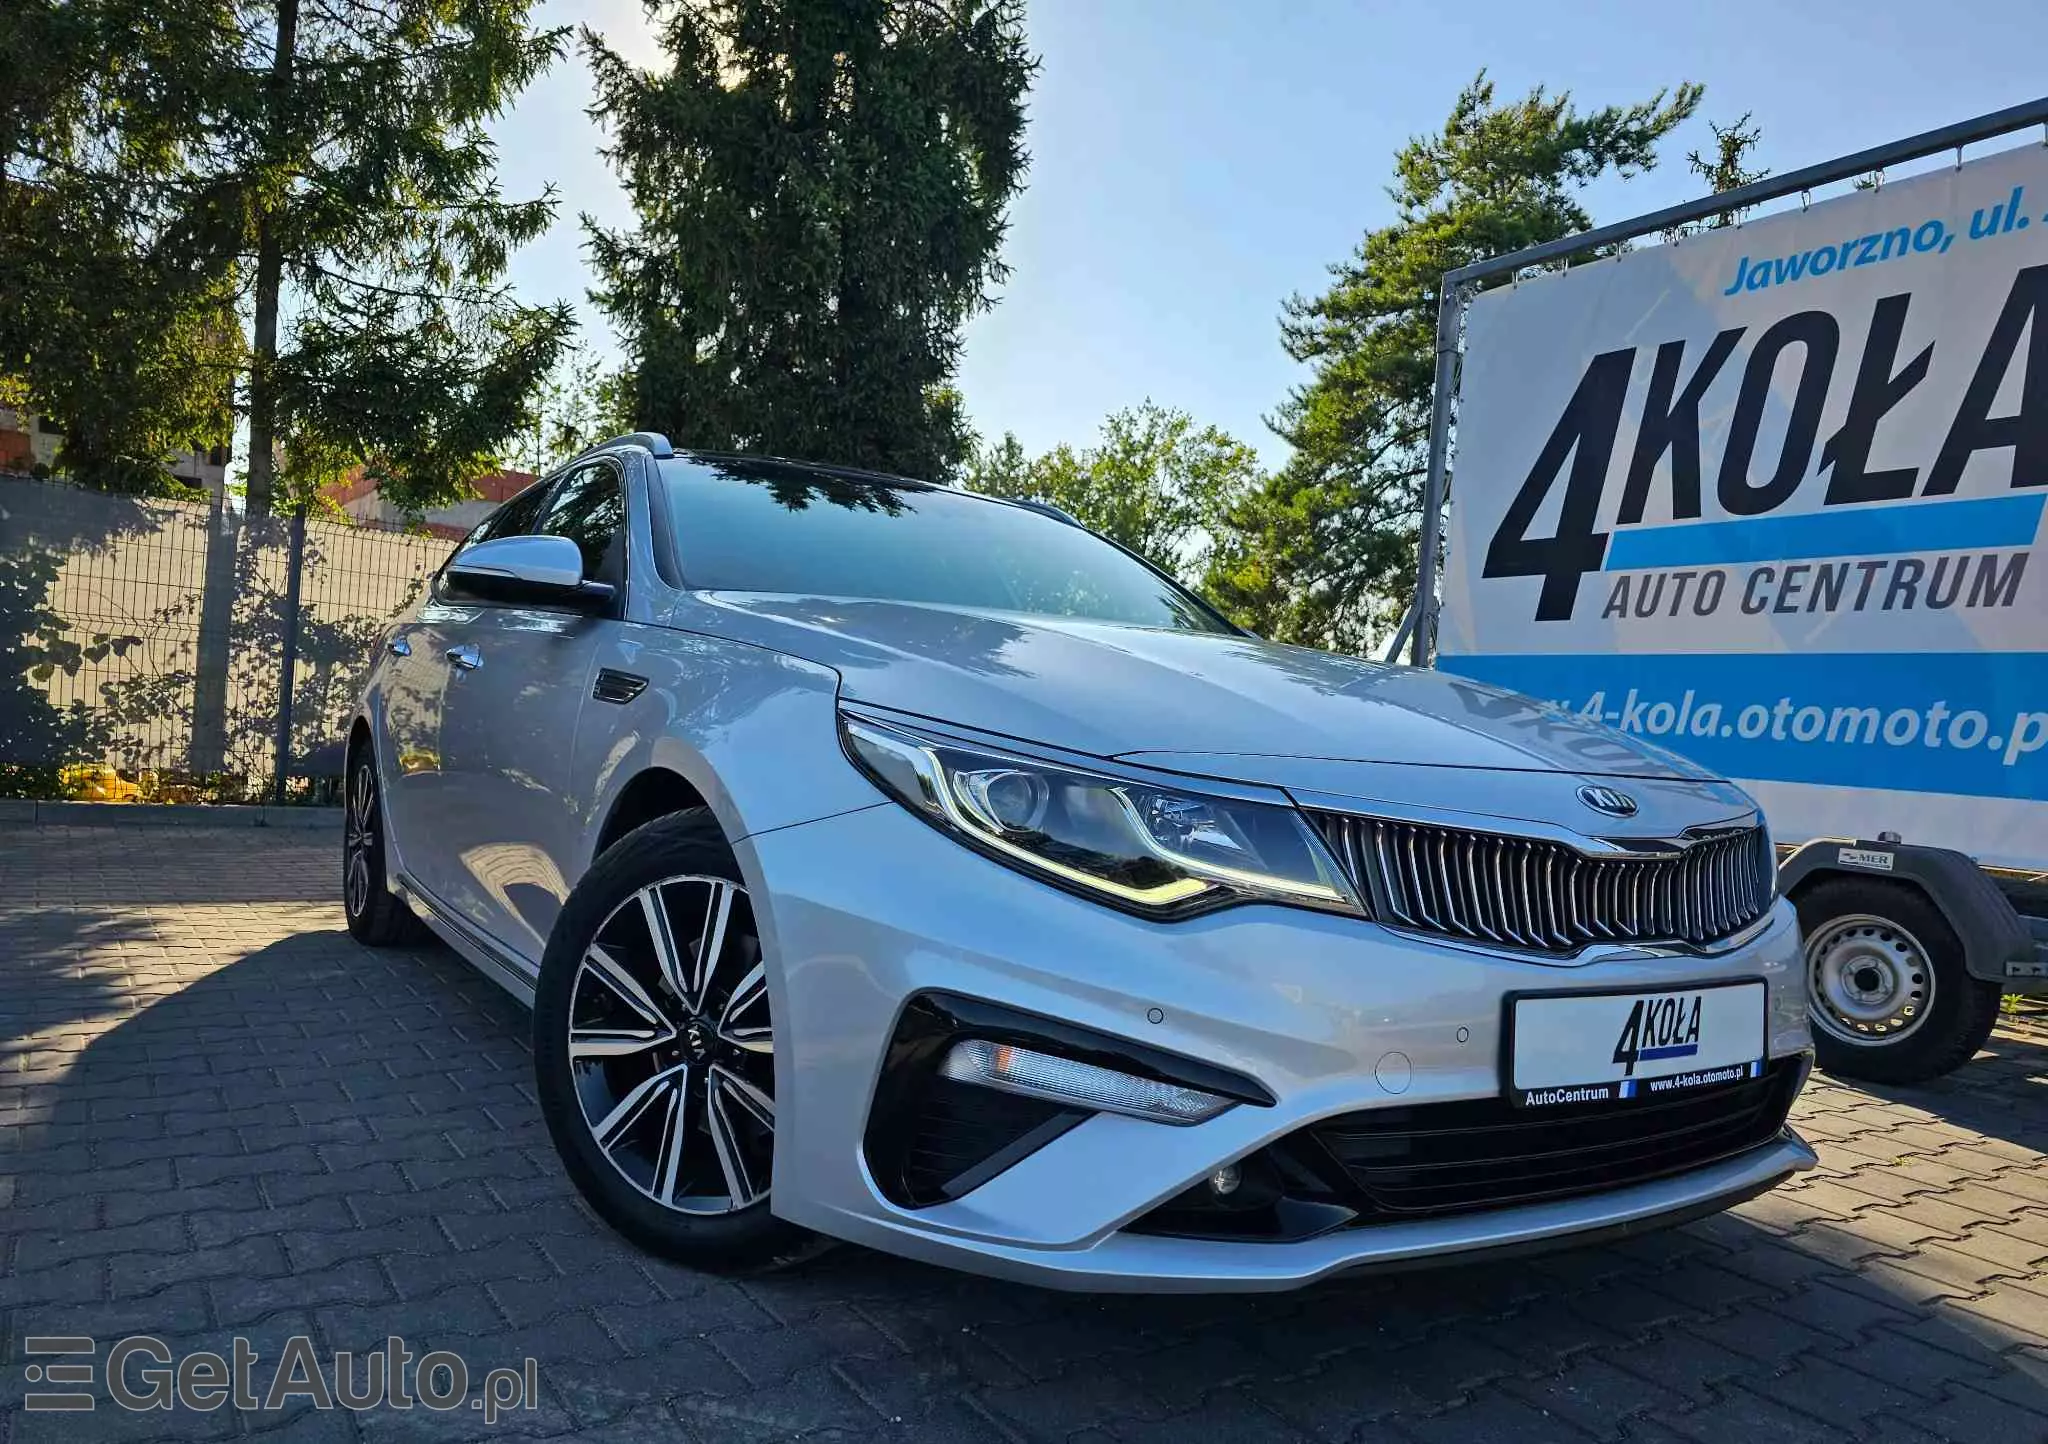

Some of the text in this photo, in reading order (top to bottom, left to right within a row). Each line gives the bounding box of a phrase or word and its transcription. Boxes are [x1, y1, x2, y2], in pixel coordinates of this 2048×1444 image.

[1724, 186, 2030, 296] Jaworzno, ul.
[1601, 552, 2030, 619] AUTO CENTRUM
[1525, 1087, 1609, 1106] AutoCentrum
[1650, 1065, 1744, 1092] www.4-kola.otomoto.pl
